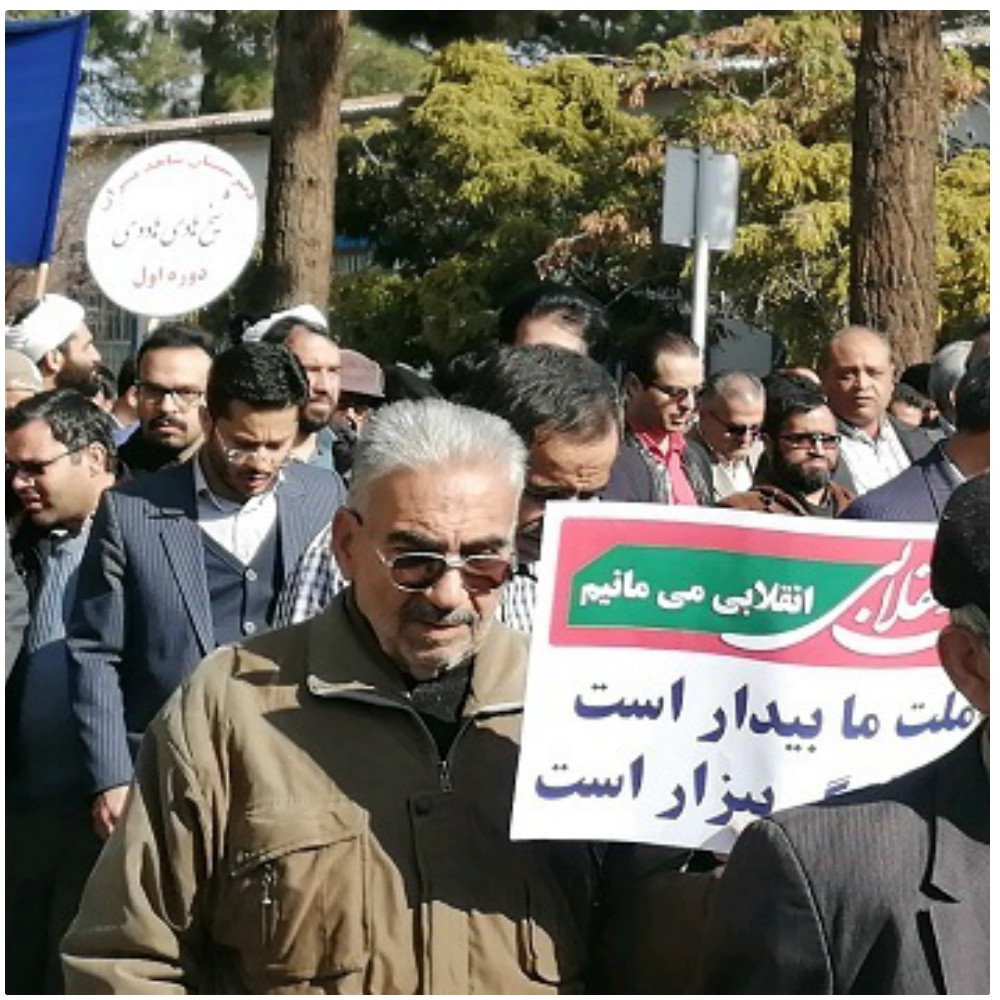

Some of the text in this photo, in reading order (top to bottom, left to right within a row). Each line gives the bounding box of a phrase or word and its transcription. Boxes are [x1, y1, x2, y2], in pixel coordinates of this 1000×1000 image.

[132, 266, 207, 289] دوره اول
[579, 568, 815, 616] انقلابی می مانیم
[573, 677, 976, 754] ملت ما بیدار است
[534, 755, 646, 800] است
